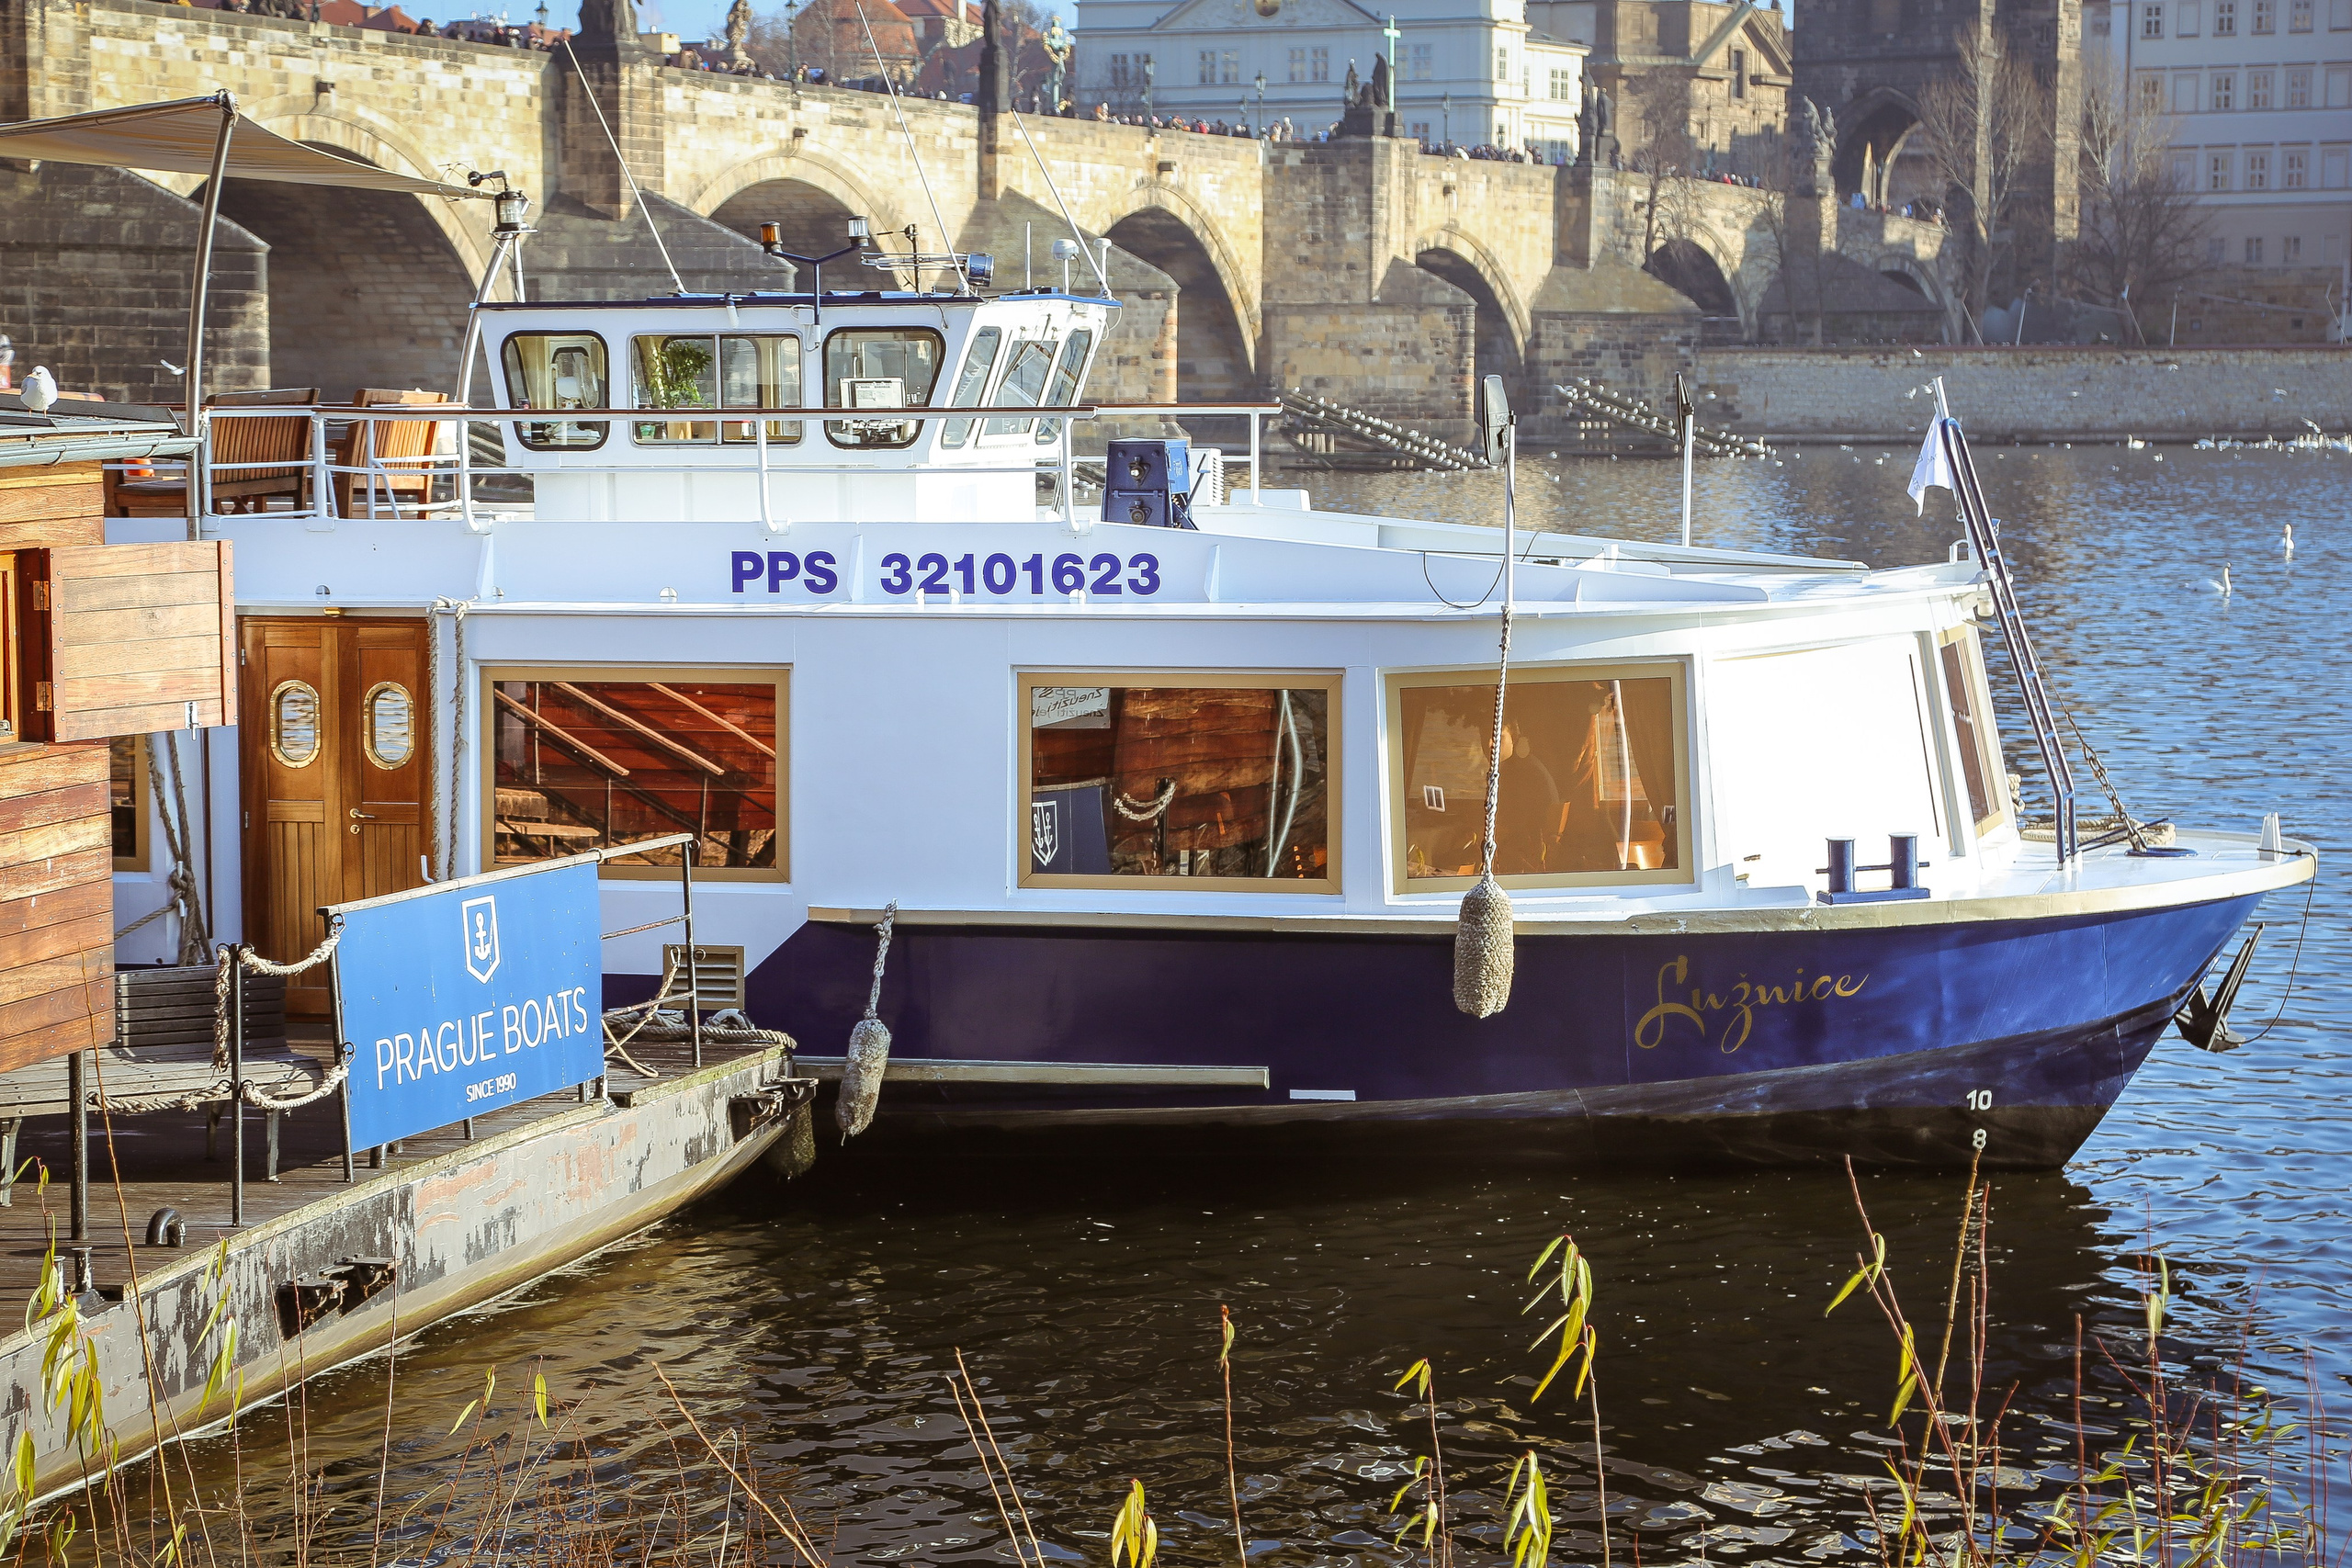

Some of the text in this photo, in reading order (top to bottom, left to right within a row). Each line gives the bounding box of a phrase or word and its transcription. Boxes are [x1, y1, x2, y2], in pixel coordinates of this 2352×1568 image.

[730, 550, 1161, 595] PPS 32101623
[1634, 954, 1869, 1054] Lužnice
[375, 986, 588, 1090] PRAGUE BOATS
[466, 1071, 517, 1103] SINCE 1990
[1966, 1089, 1992, 1111] 10
[1973, 1128, 1987, 1150] 8
